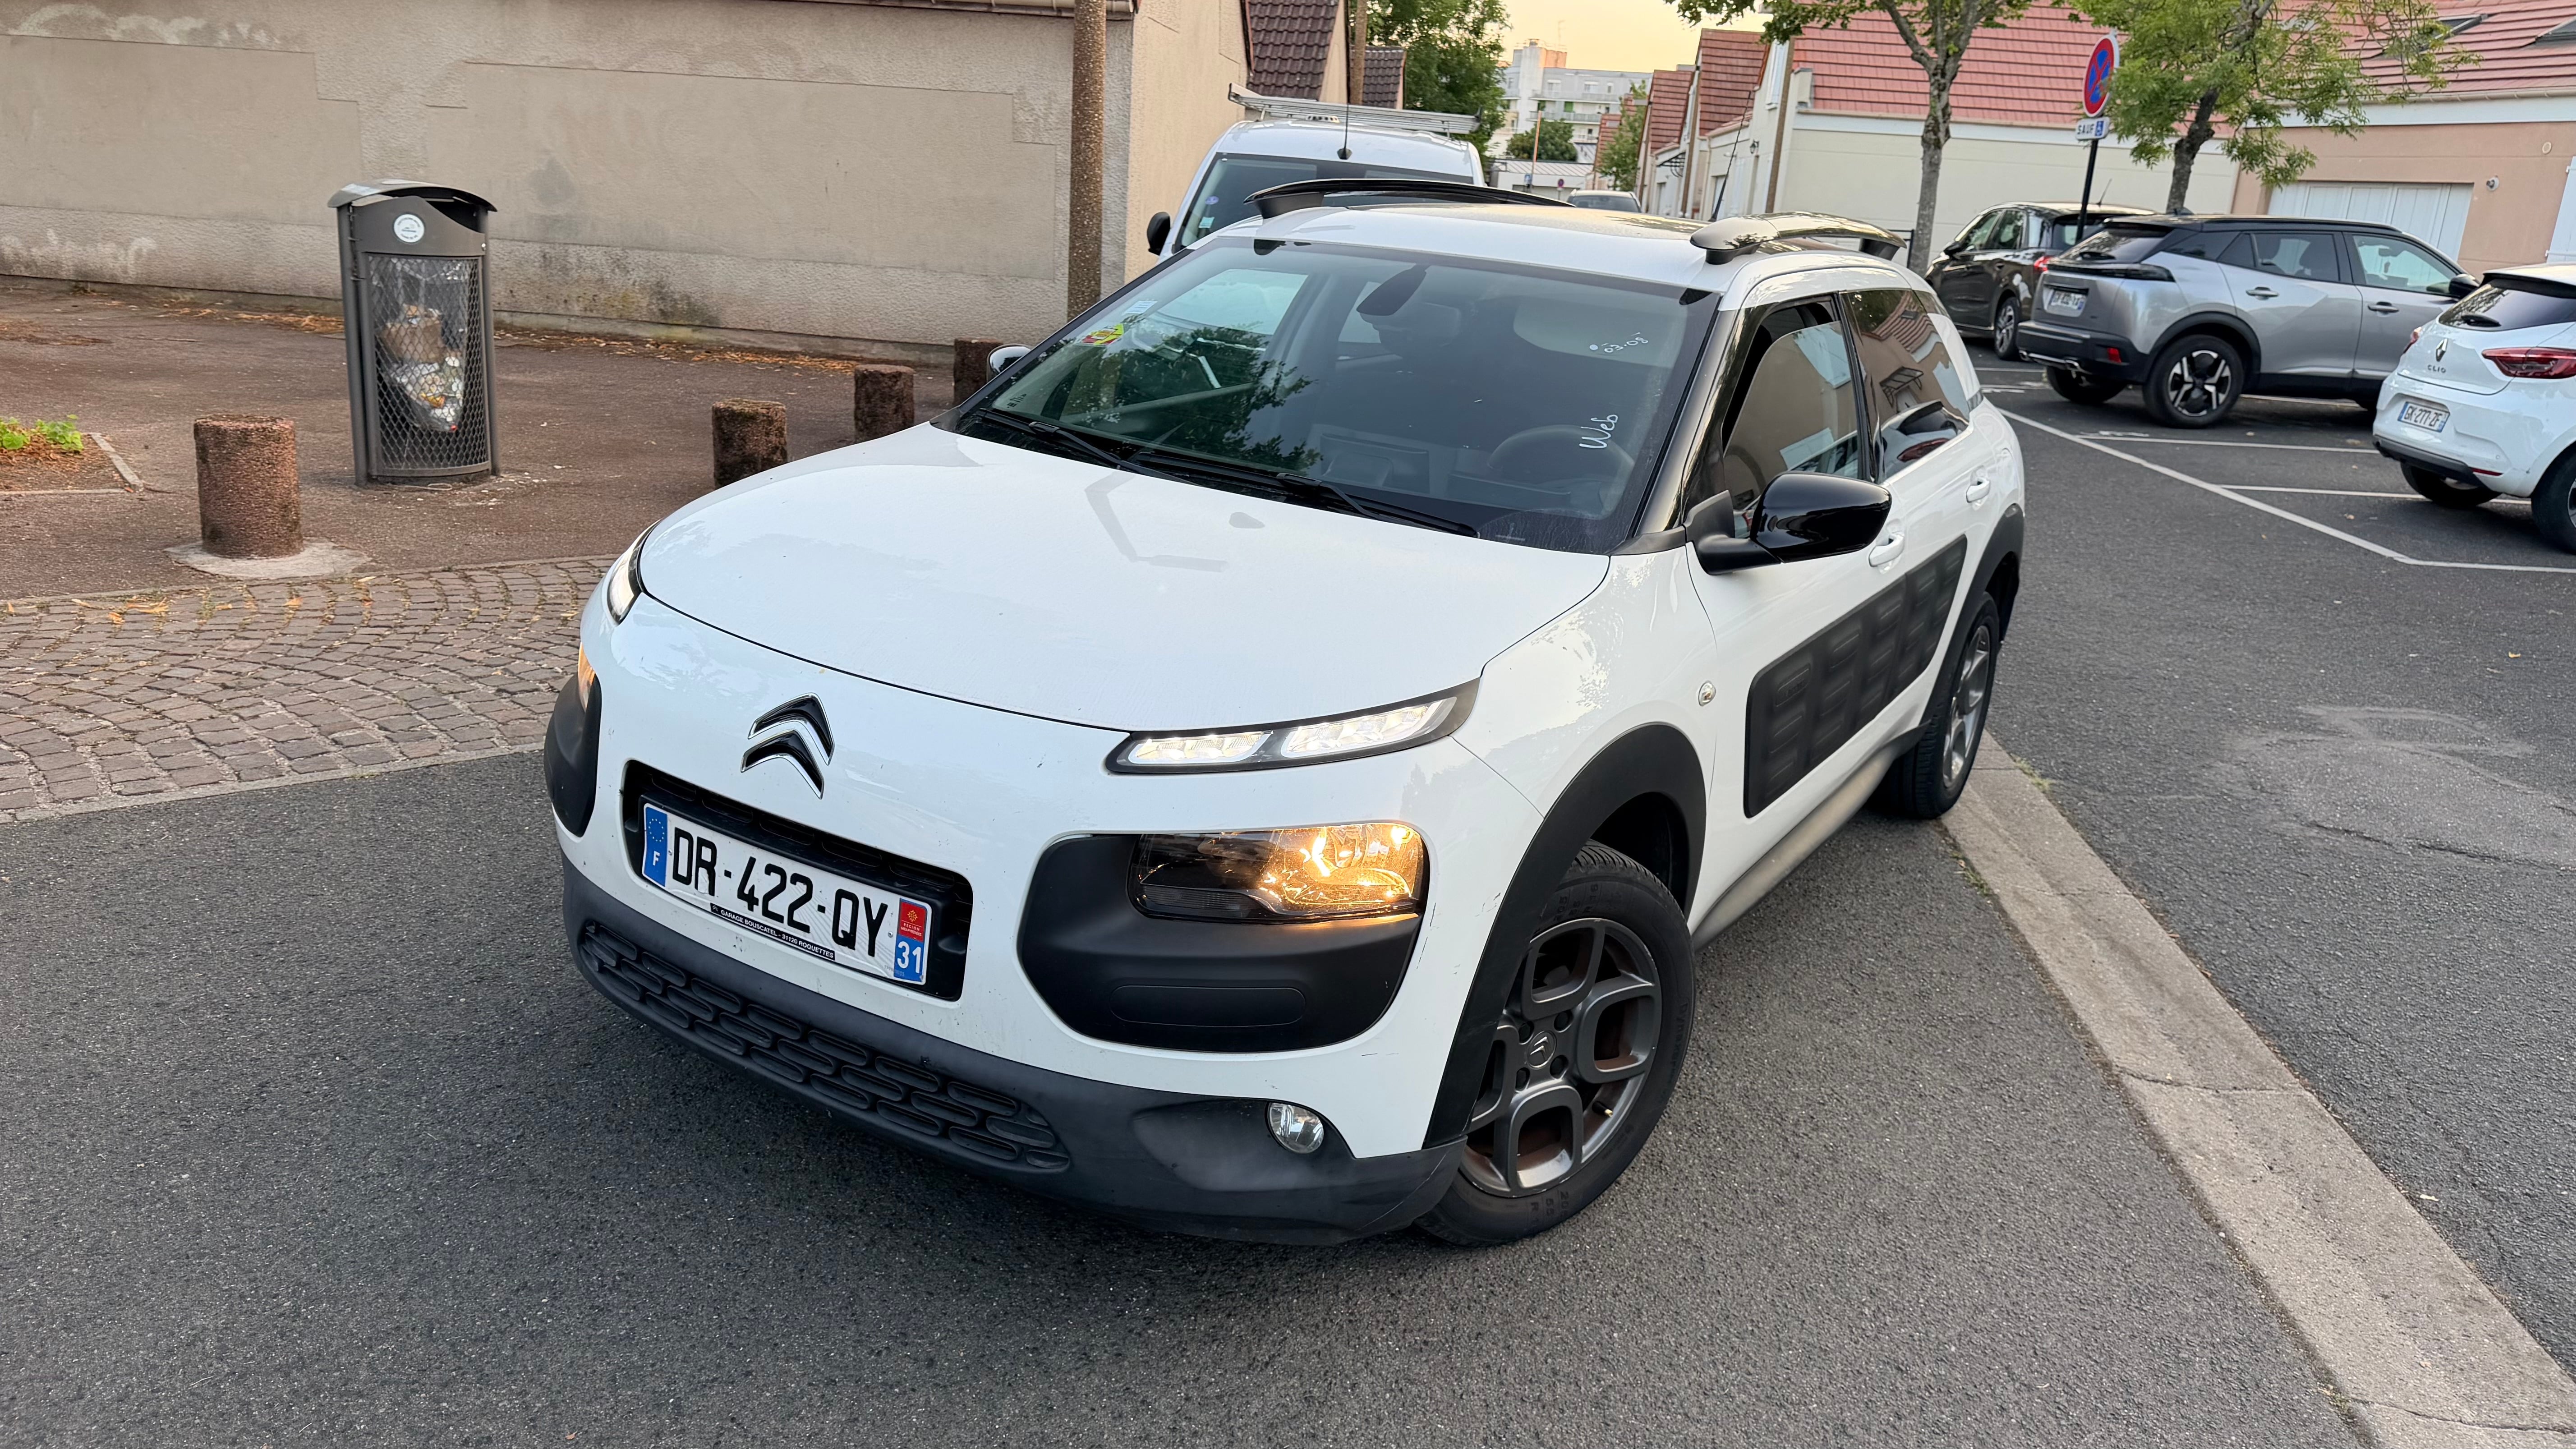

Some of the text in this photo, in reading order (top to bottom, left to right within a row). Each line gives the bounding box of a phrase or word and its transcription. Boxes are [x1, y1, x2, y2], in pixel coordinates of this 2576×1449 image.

[2427, 364, 2446, 373] CLIO
[1579, 414, 1618, 448] Web
[653, 851, 660, 866] F
[672, 827, 888, 957] DR-422-QY
[721, 910, 744, 923] GARAGE
[744, 919, 778, 937] BOUSCATEL
[782, 934, 798, 944] 31120
[798, 940, 834, 959] ROQUETTES
[897, 941, 921, 974] 31
